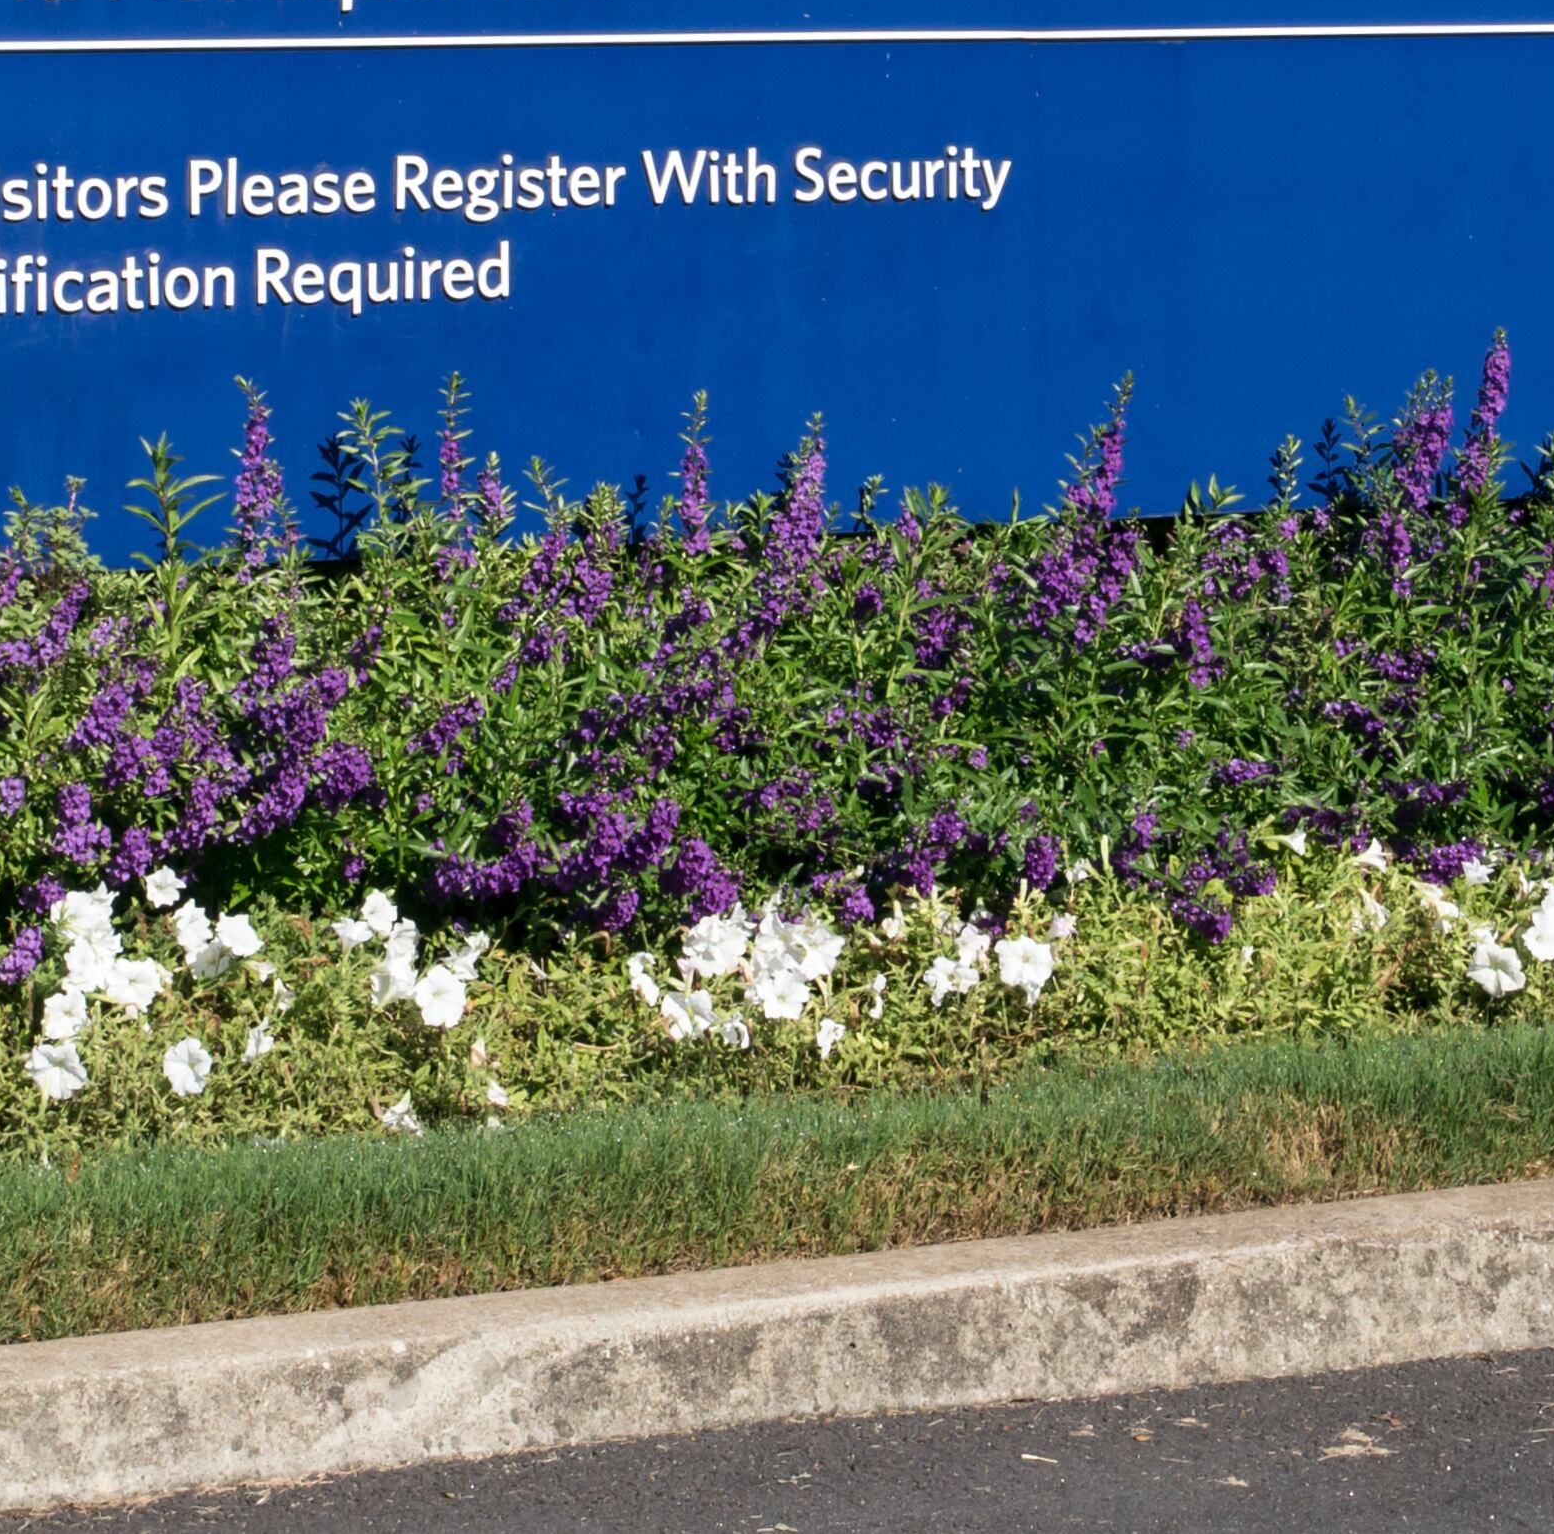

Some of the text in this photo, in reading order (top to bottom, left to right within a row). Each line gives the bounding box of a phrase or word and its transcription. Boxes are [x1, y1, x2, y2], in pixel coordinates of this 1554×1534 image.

[188, 157, 376, 216] Please
[394, 153, 627, 222] Register
[642, 146, 777, 205] With
[793, 145, 1012, 210] Security
[255, 240, 511, 315] Required
